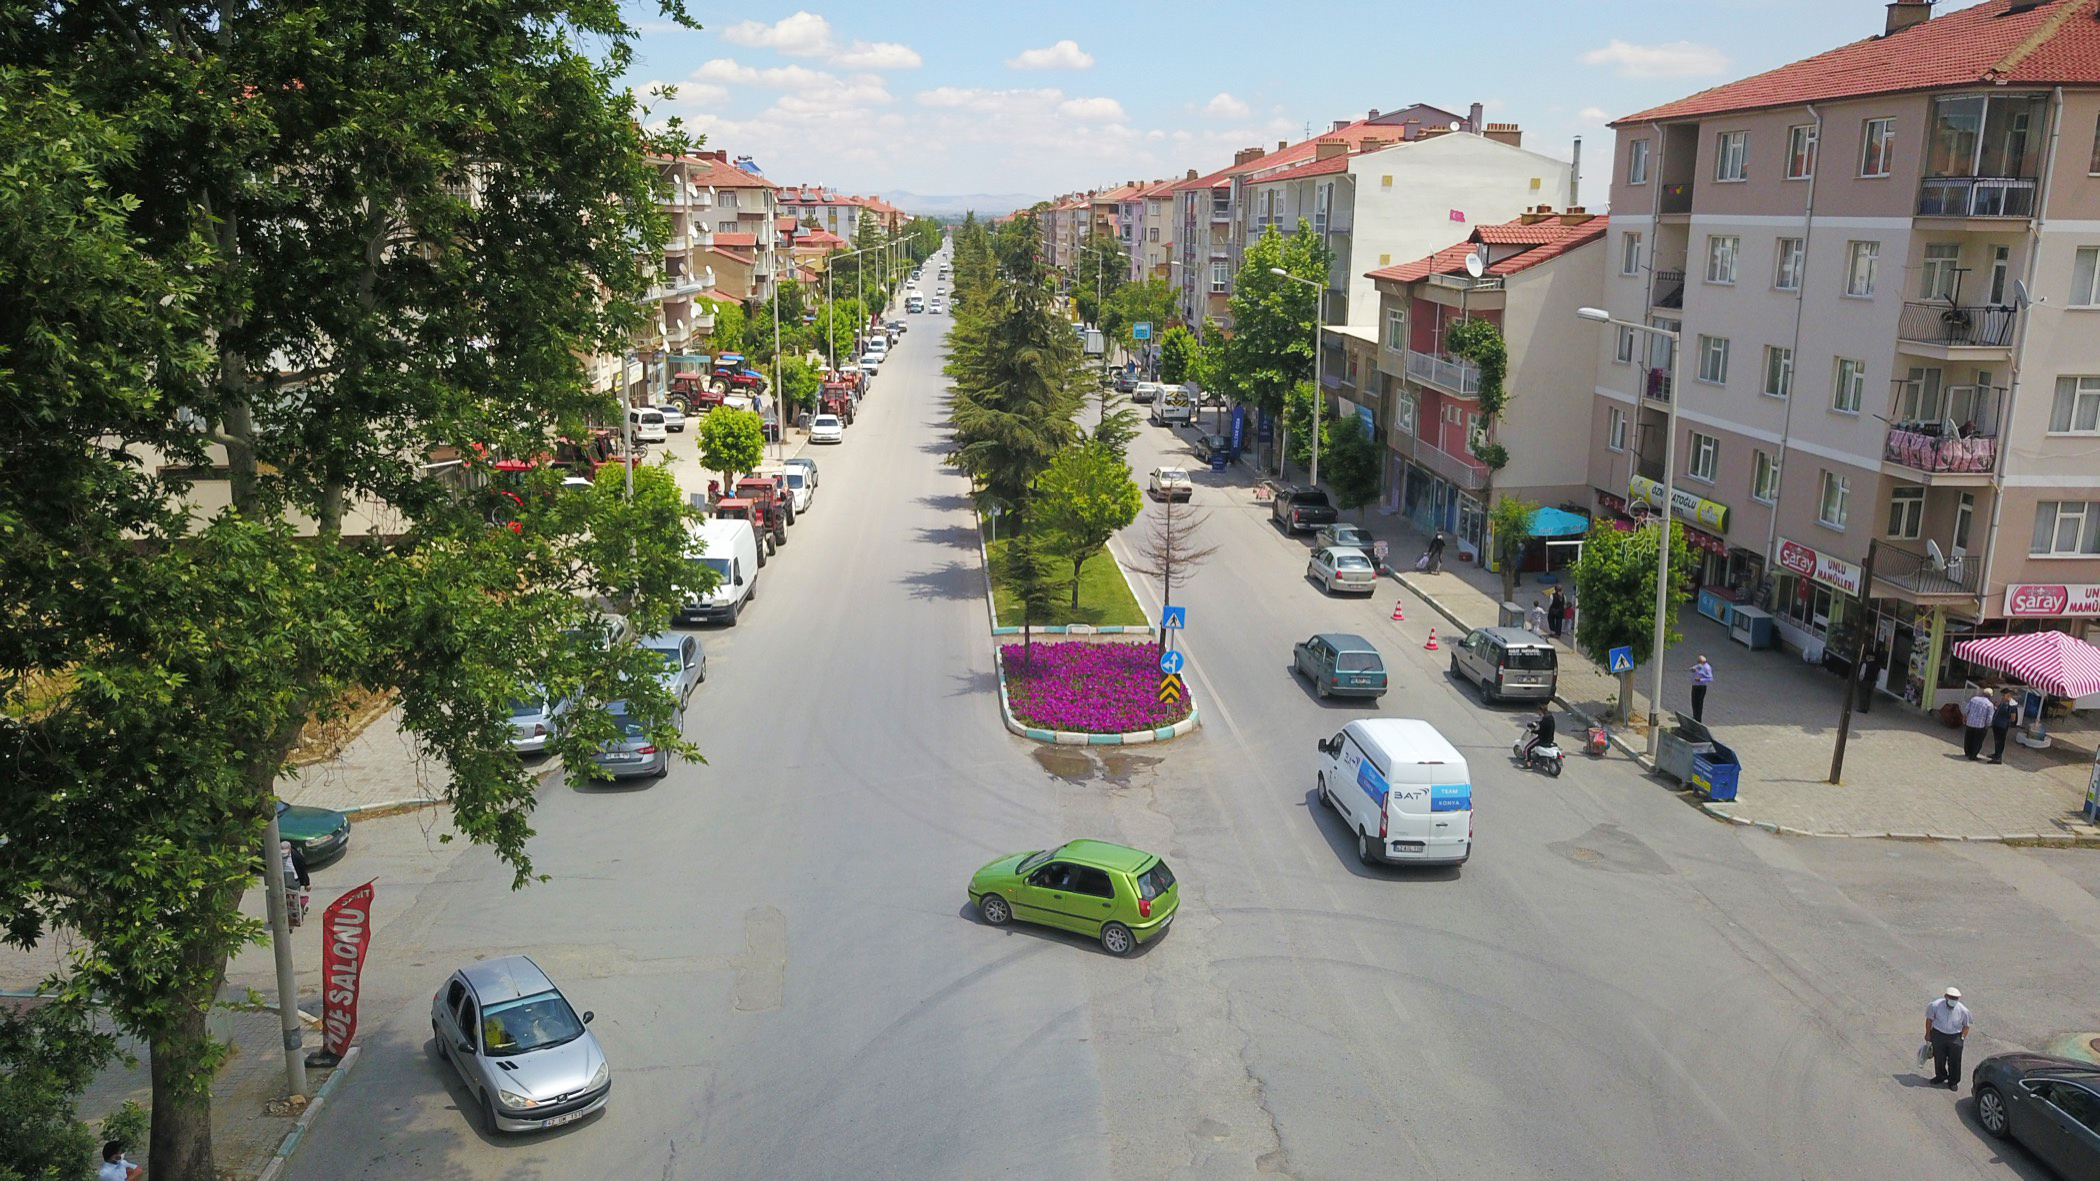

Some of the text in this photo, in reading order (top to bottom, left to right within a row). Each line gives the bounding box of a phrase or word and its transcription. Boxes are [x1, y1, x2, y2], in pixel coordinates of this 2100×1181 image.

[1782, 549, 1814, 574] Saray
[2015, 595, 2064, 612] Saray
[1394, 791, 1422, 800] BAT
[329, 908, 365, 1005] SALONU
